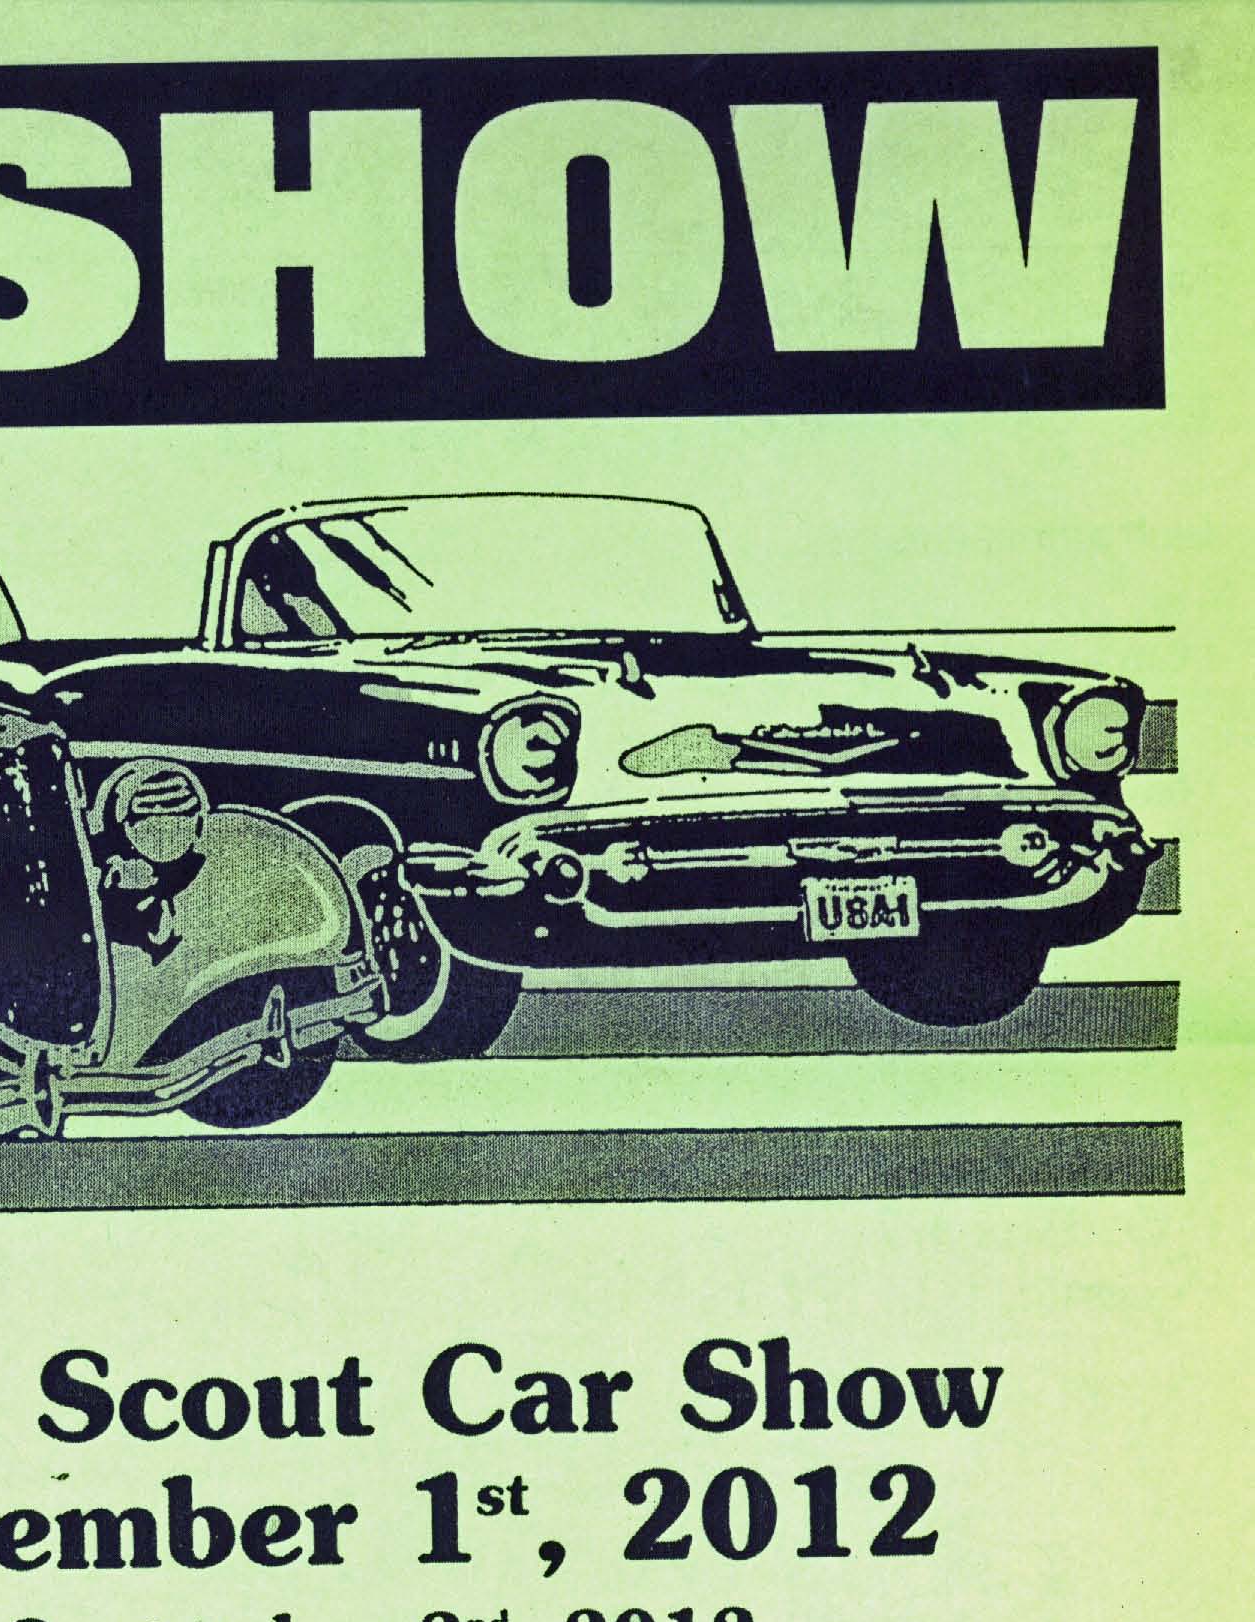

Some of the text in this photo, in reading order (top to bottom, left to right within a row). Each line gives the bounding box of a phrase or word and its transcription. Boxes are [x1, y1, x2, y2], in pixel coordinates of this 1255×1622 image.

[36, 1348, 377, 1445] Scout
[421, 1341, 635, 1438] Car
[679, 1334, 1005, 1435] Show
[414, 1470, 568, 1580] 1st,
[622, 1462, 940, 1562] 2012
